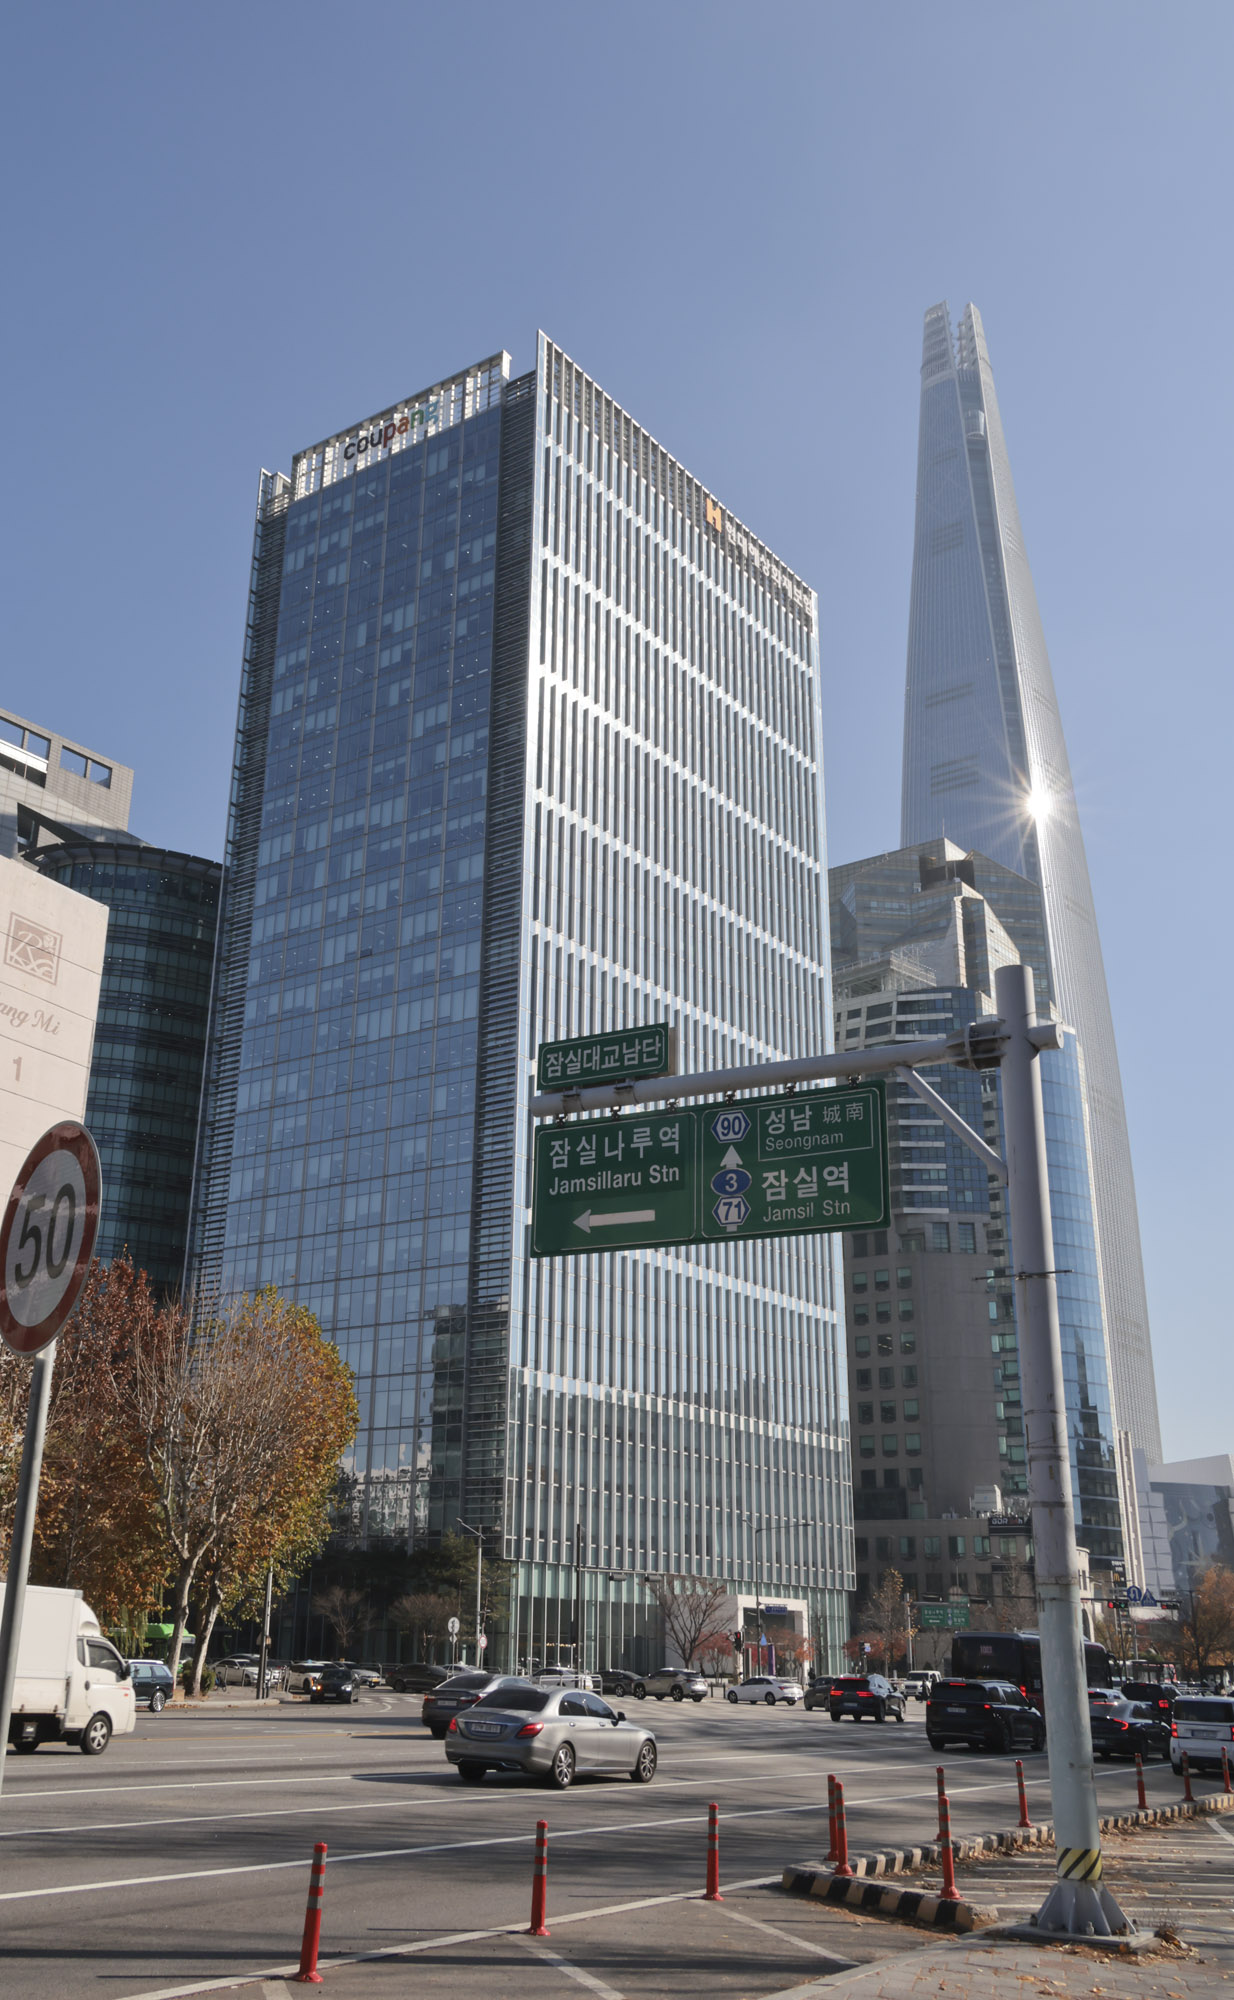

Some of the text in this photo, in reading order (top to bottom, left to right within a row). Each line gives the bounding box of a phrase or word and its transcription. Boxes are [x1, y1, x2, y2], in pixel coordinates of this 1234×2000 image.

[344, 398, 439, 460] coupang
[725, 521, 812, 616] 현대해상화재보험
[0, 1001, 61, 1036] ang Mi
[13, 1056, 23, 1082] 1
[545, 1035, 662, 1078] 잠실대교남단
[721, 1115, 742, 1137] 90
[765, 1102, 864, 1135] 성남 城南
[549, 1123, 680, 1169] 잠실나루역
[765, 1132, 844, 1152] Seongnam
[549, 1164, 680, 1196] Jamsillaru Stn
[725, 1173, 738, 1193] 3
[761, 1161, 850, 1202] 잠실역
[722, 1201, 742, 1222] 71
[763, 1200, 851, 1223] Jamsil Stn
[14, 1182, 76, 1289] 50
